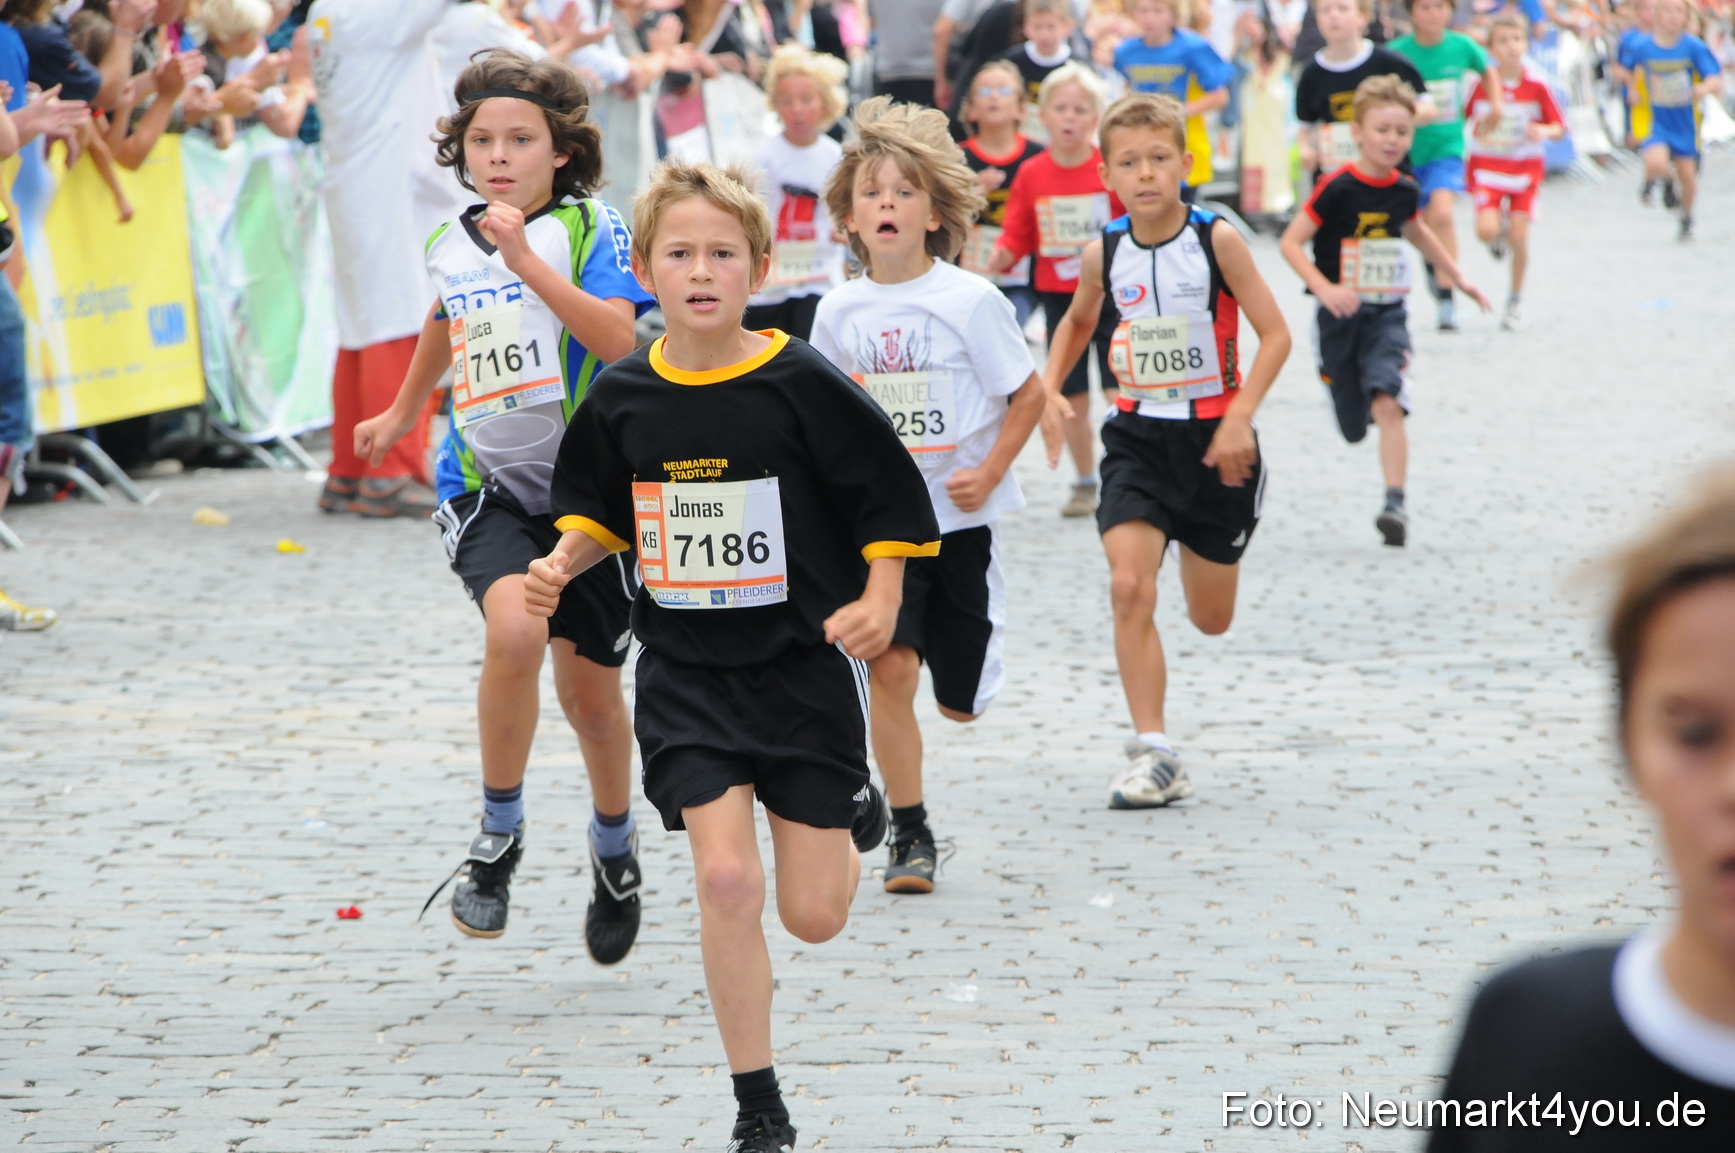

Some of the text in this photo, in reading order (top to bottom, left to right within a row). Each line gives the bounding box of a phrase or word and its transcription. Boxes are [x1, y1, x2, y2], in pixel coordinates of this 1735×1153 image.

[444, 268, 490, 289] TEAM
[466, 321, 493, 342] Luca
[1131, 324, 1177, 342] Florian
[470, 339, 543, 383] 7161
[1135, 347, 1203, 375] 7088
[516, 383, 562, 401] PFLEIDERER
[866, 383, 939, 405] MANUEL
[887, 410, 945, 436] 253
[663, 458, 729, 471] NEUMARKTER
[670, 468, 722, 480] STADTLAUF
[670, 495, 724, 518] Jonas
[641, 531, 657, 549] K6
[674, 531, 770, 567] 7186
[656, 592, 689, 602] BOCK
[727, 584, 784, 599] PFLEIDERER
